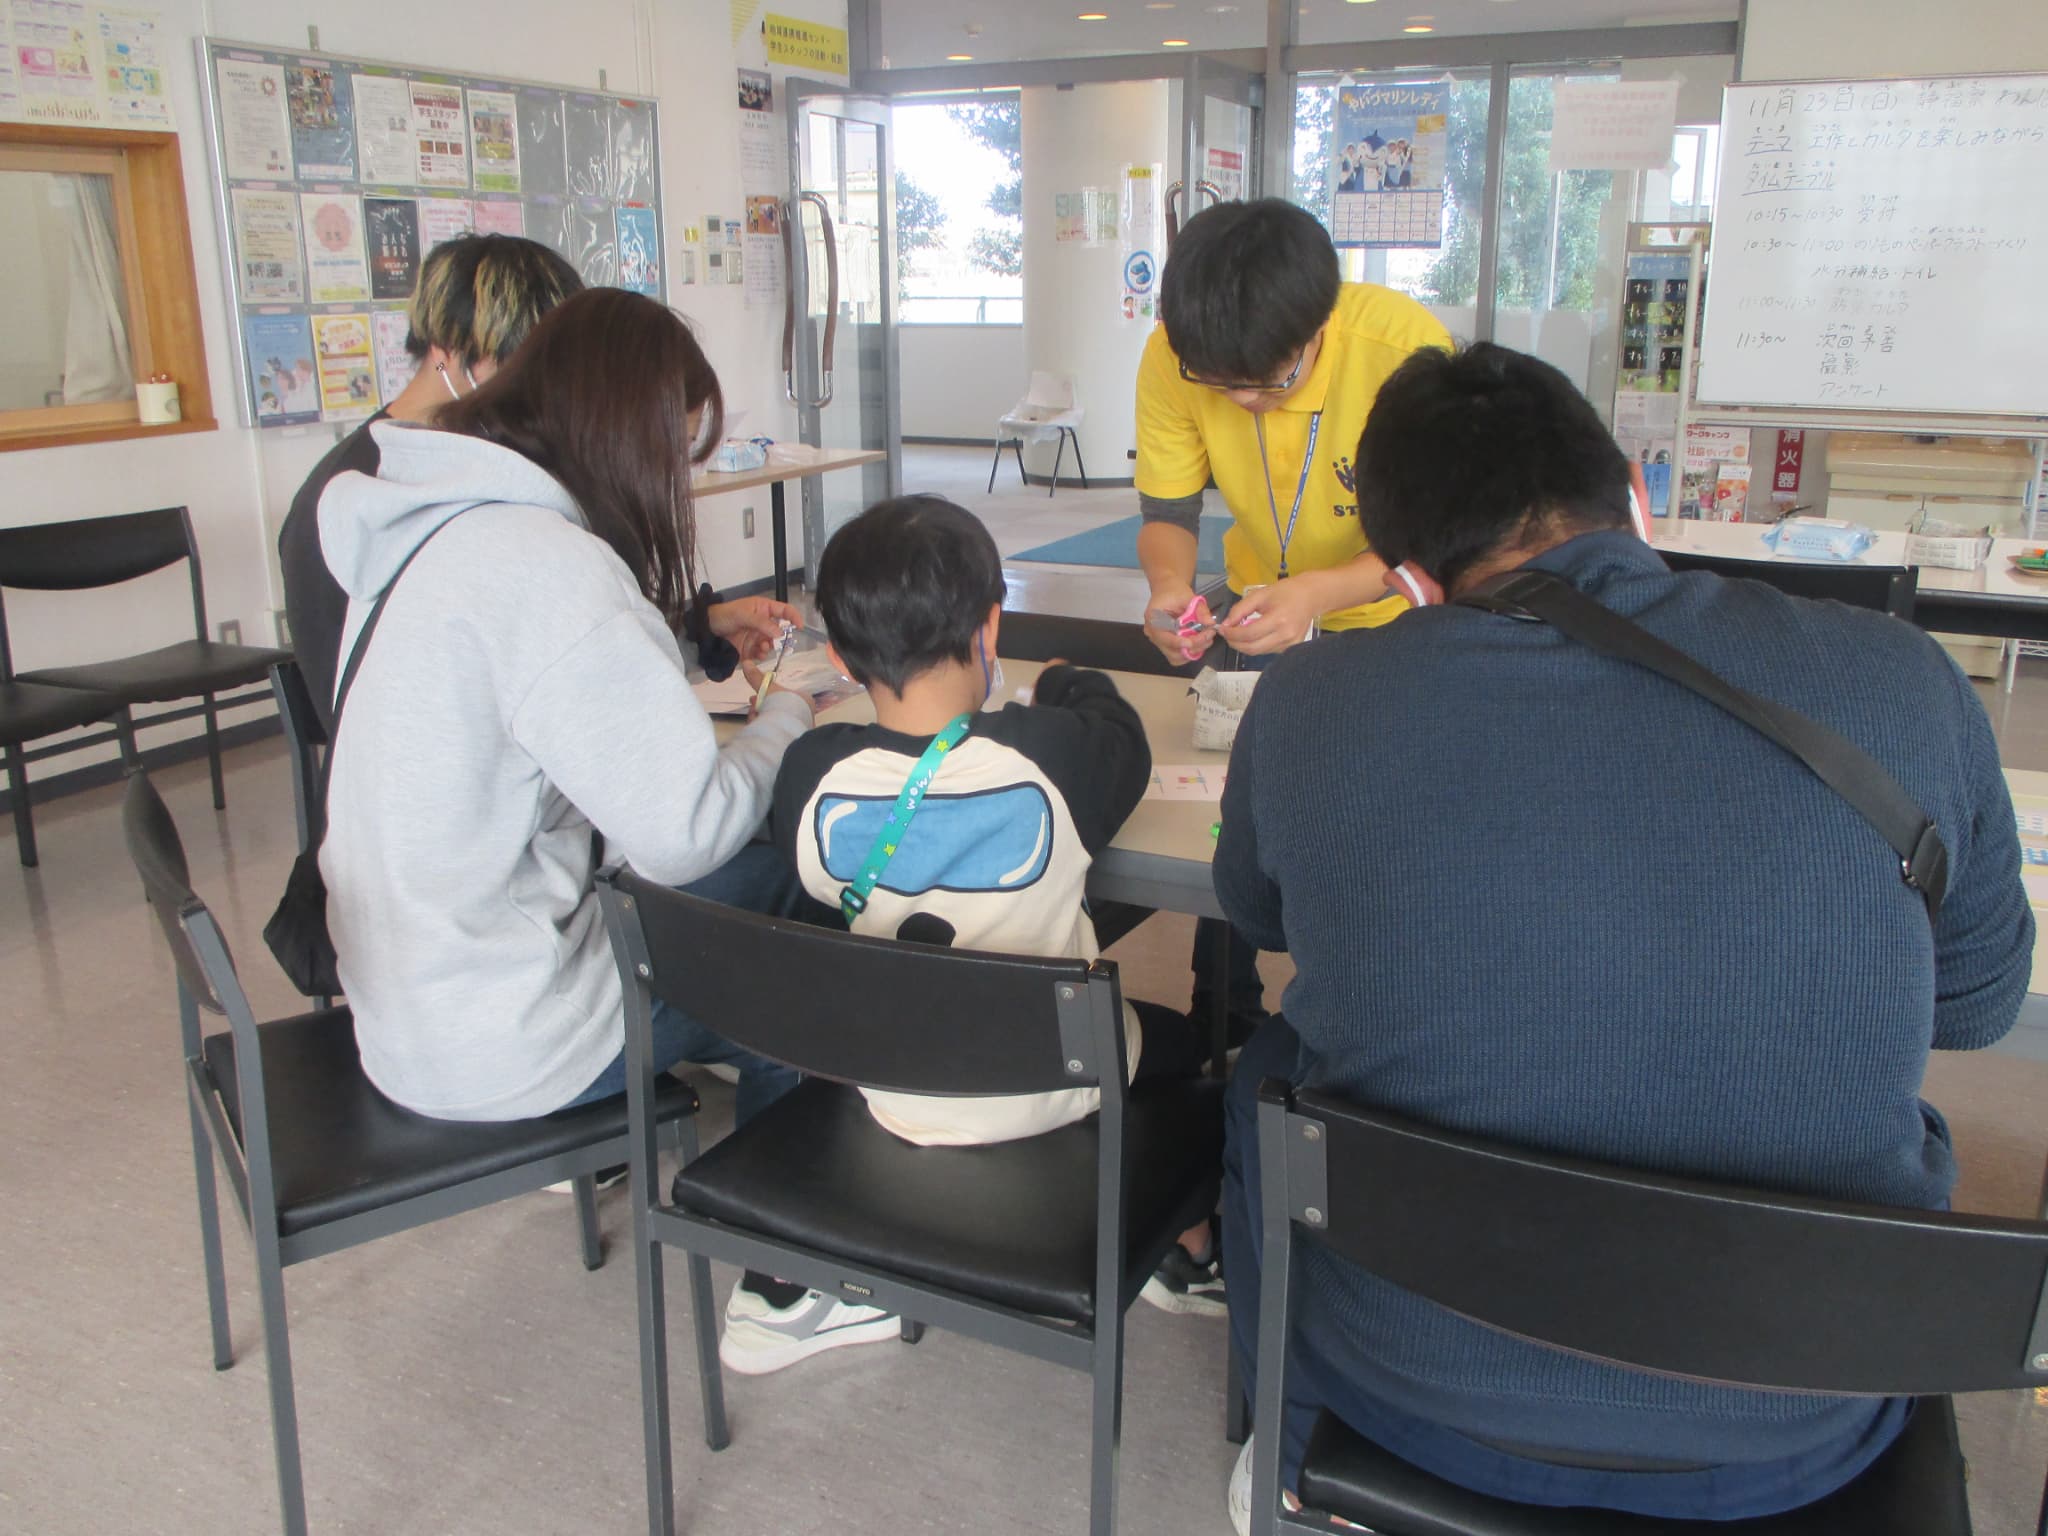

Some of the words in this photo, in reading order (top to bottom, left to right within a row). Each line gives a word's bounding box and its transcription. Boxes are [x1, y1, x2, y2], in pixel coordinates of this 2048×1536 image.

[418, 107, 458, 119] 学生スタッフ
[1745, 136, 1793, 153] テーマ
[1818, 381, 1890, 399] アンケート
[1778, 430, 1801, 488] 消火器
[1333, 504, 1360, 518] ST
[843, 1282, 871, 1296] KOKUYO
